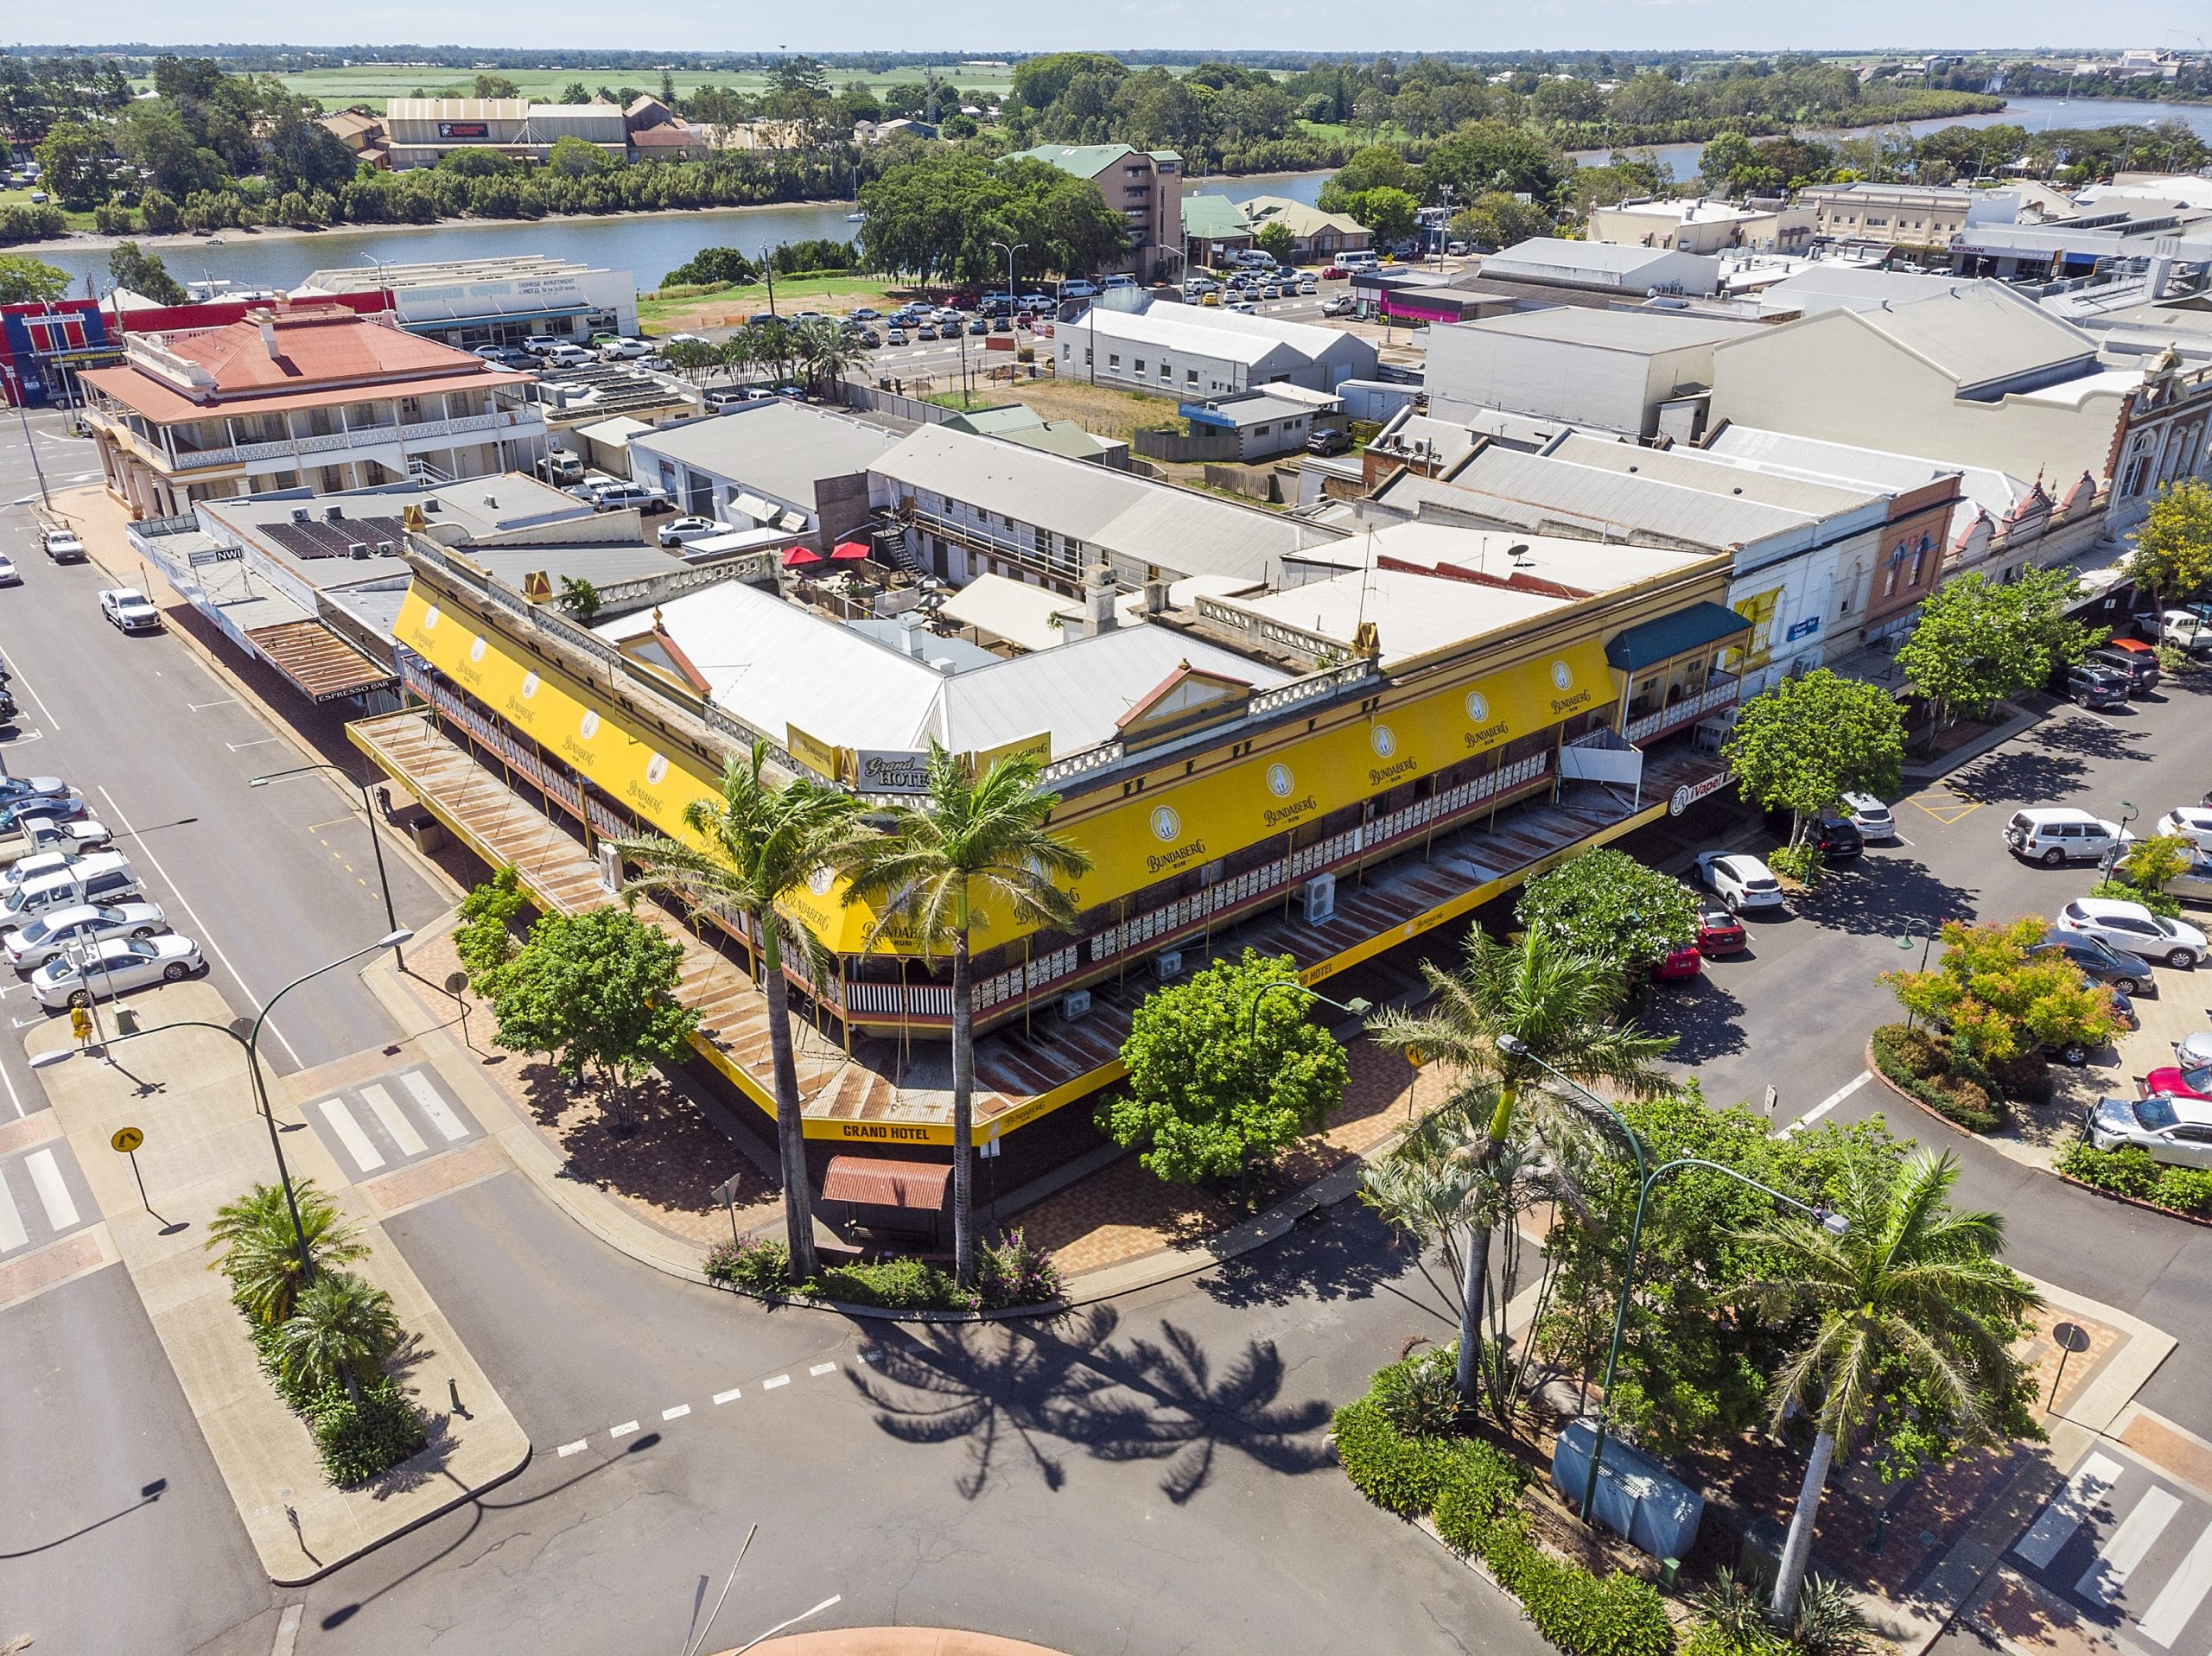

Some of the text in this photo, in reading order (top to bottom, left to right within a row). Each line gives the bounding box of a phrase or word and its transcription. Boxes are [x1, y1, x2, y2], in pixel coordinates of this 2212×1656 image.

[218, 549, 242, 561] NWI
[318, 681, 390, 702] ESPRESSO BAR
[1551, 688, 1591, 715] BUNDABERG
[505, 695, 536, 724] BUNDABERG
[1465, 720, 1509, 748] BUNDABERG
[562, 735, 596, 767] BUNDABERG
[864, 756, 916, 777] Grand
[1369, 756, 1418, 786] BUNDABERG
[626, 779, 664, 815] BUNDABERG
[1690, 773, 1723, 800] iVape!
[638, 802, 646, 810] RUM
[1263, 795, 1318, 828] BUNDABERG
[1287, 815, 1300, 823] RUM
[1146, 838, 1207, 873] BUNDABERG
[1173, 860, 1187, 869] RUM
[785, 889, 831, 932] BUNDABERG
[1309, 962, 1332, 981] HOTEL
[1003, 1101, 1046, 1127] BUNDABERG
[843, 1125, 930, 1140] GRAND HOTEL
